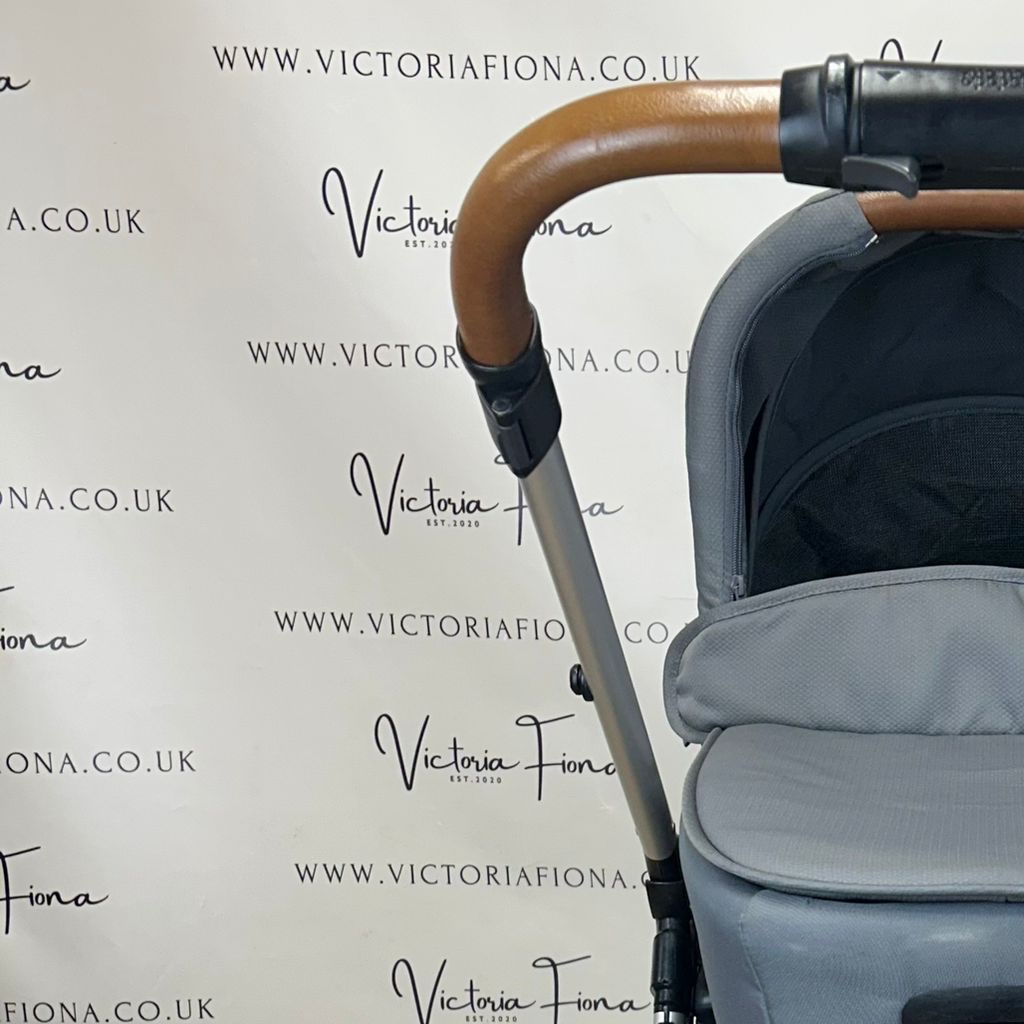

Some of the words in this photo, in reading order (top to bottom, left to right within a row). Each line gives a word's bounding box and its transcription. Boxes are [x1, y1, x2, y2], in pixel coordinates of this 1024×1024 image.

[212, 46, 702, 82] WWW.VICTORIAFIONA.CO.UK
[404, 240, 454, 249] EST.20
[350, 452, 499, 536] Victoria
[426, 519, 479, 527] EST.2020
[374, 713, 520, 791] Victoria
[450, 775, 502, 784] EST.2020
